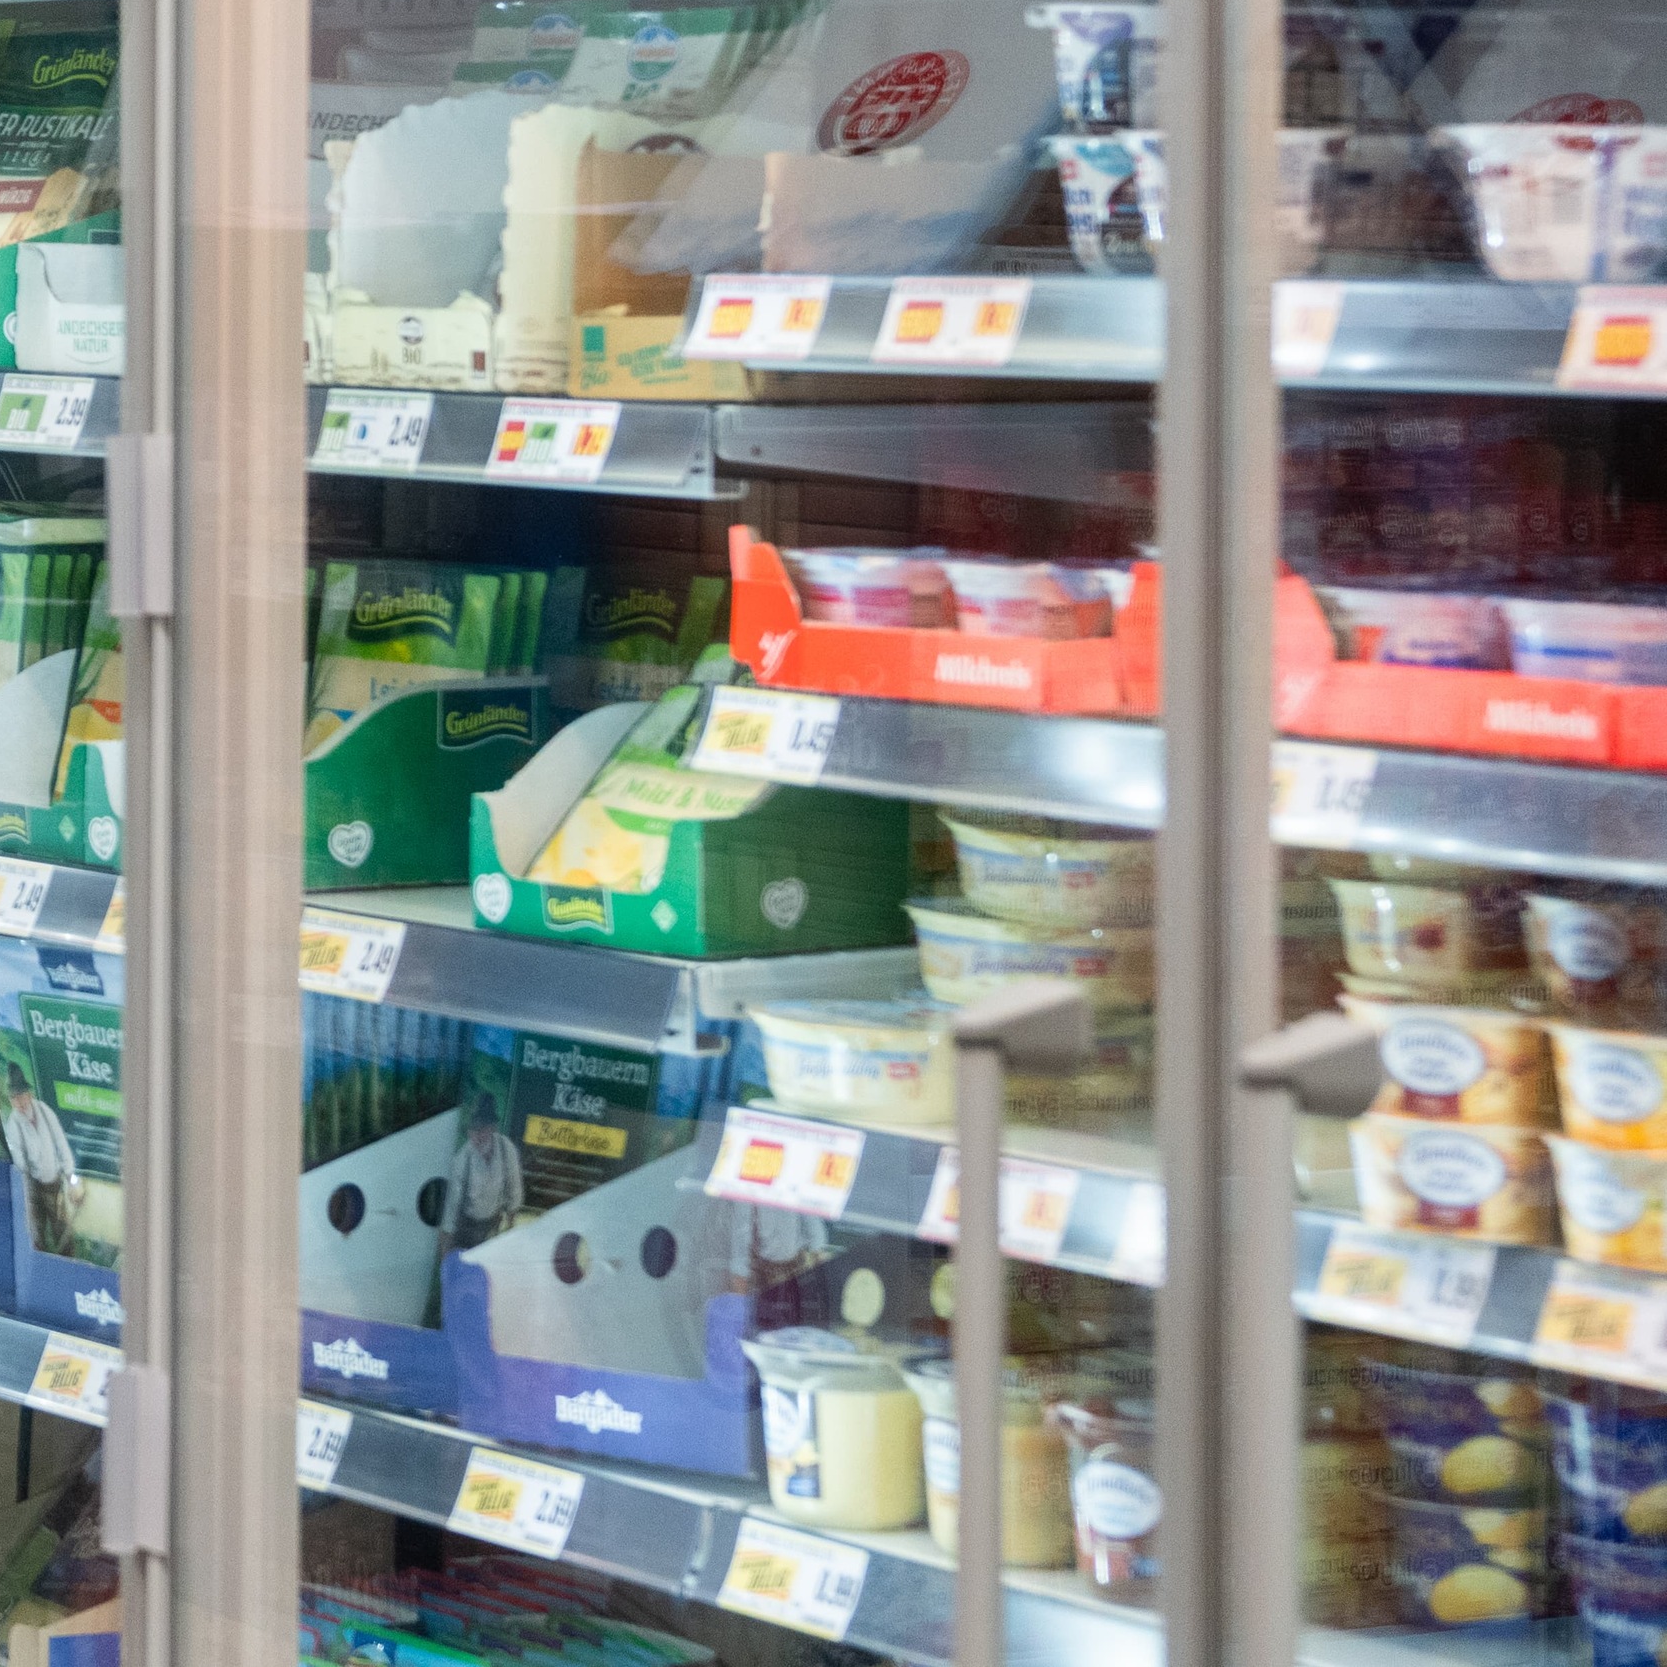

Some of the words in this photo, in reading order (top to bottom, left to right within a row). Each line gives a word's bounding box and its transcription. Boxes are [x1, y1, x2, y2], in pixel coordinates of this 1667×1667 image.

[33, 47, 116, 85] Grünländer
[73, 338, 109, 353] NATUR
[55, 396, 87, 426] 2.99
[445, 706, 529, 735] Grünländer
[66, 1051, 113, 1082] Käse
[522, 1039, 650, 1085] Bergbauern
[551, 1083, 607, 1120] Käse
[312, 1338, 389, 1380] Bergader
[555, 1390, 643, 1435] Bergader
